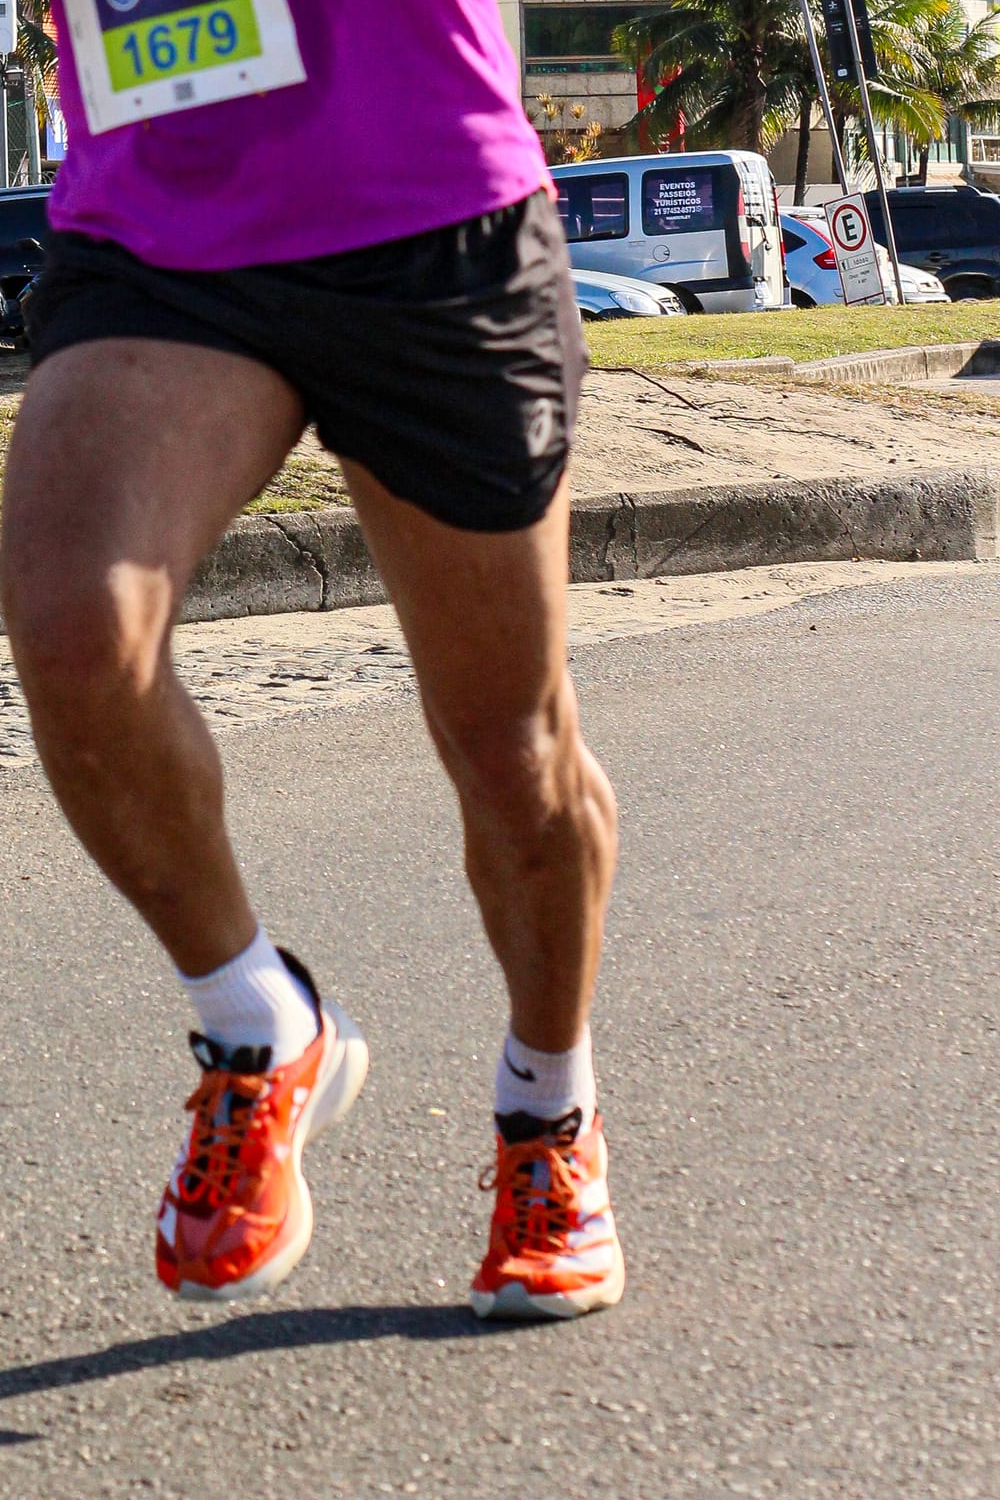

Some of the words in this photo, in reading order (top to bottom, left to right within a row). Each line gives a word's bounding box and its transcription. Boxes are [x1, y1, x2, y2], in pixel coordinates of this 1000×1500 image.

[123, 10, 238, 77] 1679
[660, 182, 696, 190] EVENTOS
[659, 190, 697, 198] PASSEIOS
[655, 198, 701, 207] TURÍSTICOS
[842, 213, 858, 241] E
